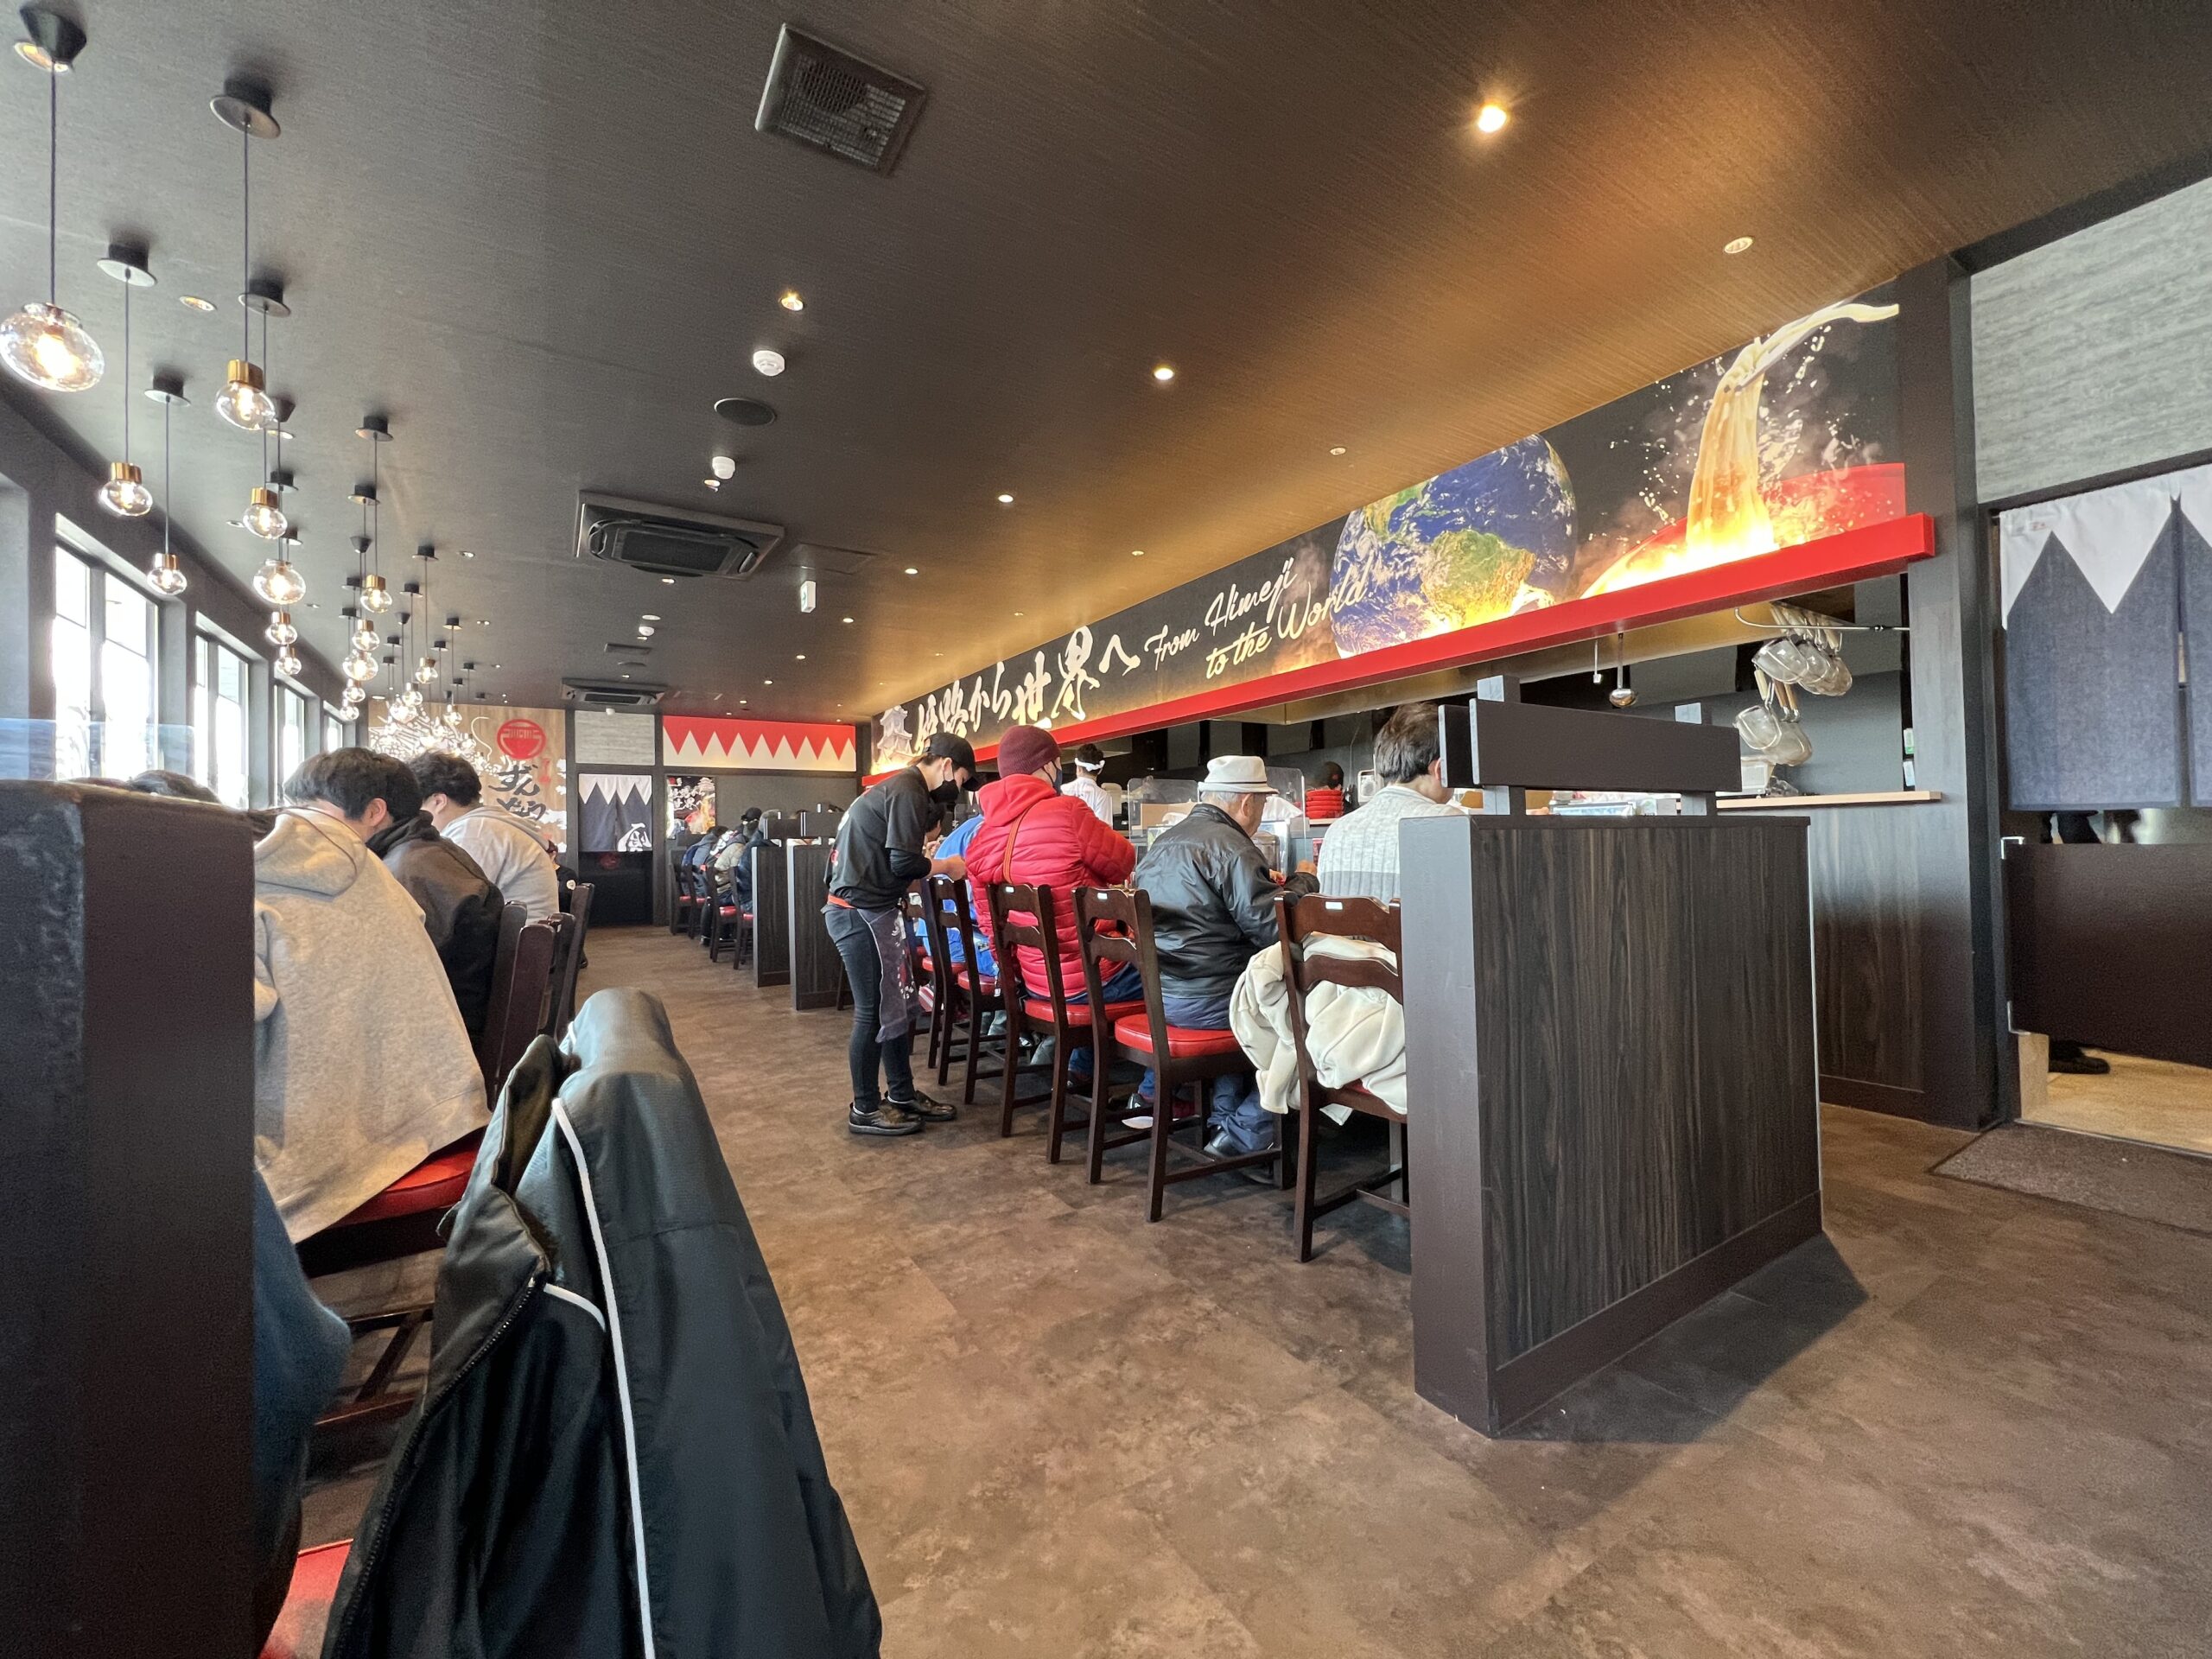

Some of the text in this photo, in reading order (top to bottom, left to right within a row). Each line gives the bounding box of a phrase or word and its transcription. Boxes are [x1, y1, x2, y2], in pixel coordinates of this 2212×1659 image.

[1144, 556, 1298, 671] From Himeji
[1206, 647, 1229, 679] to
[1229, 621, 1273, 665] the
